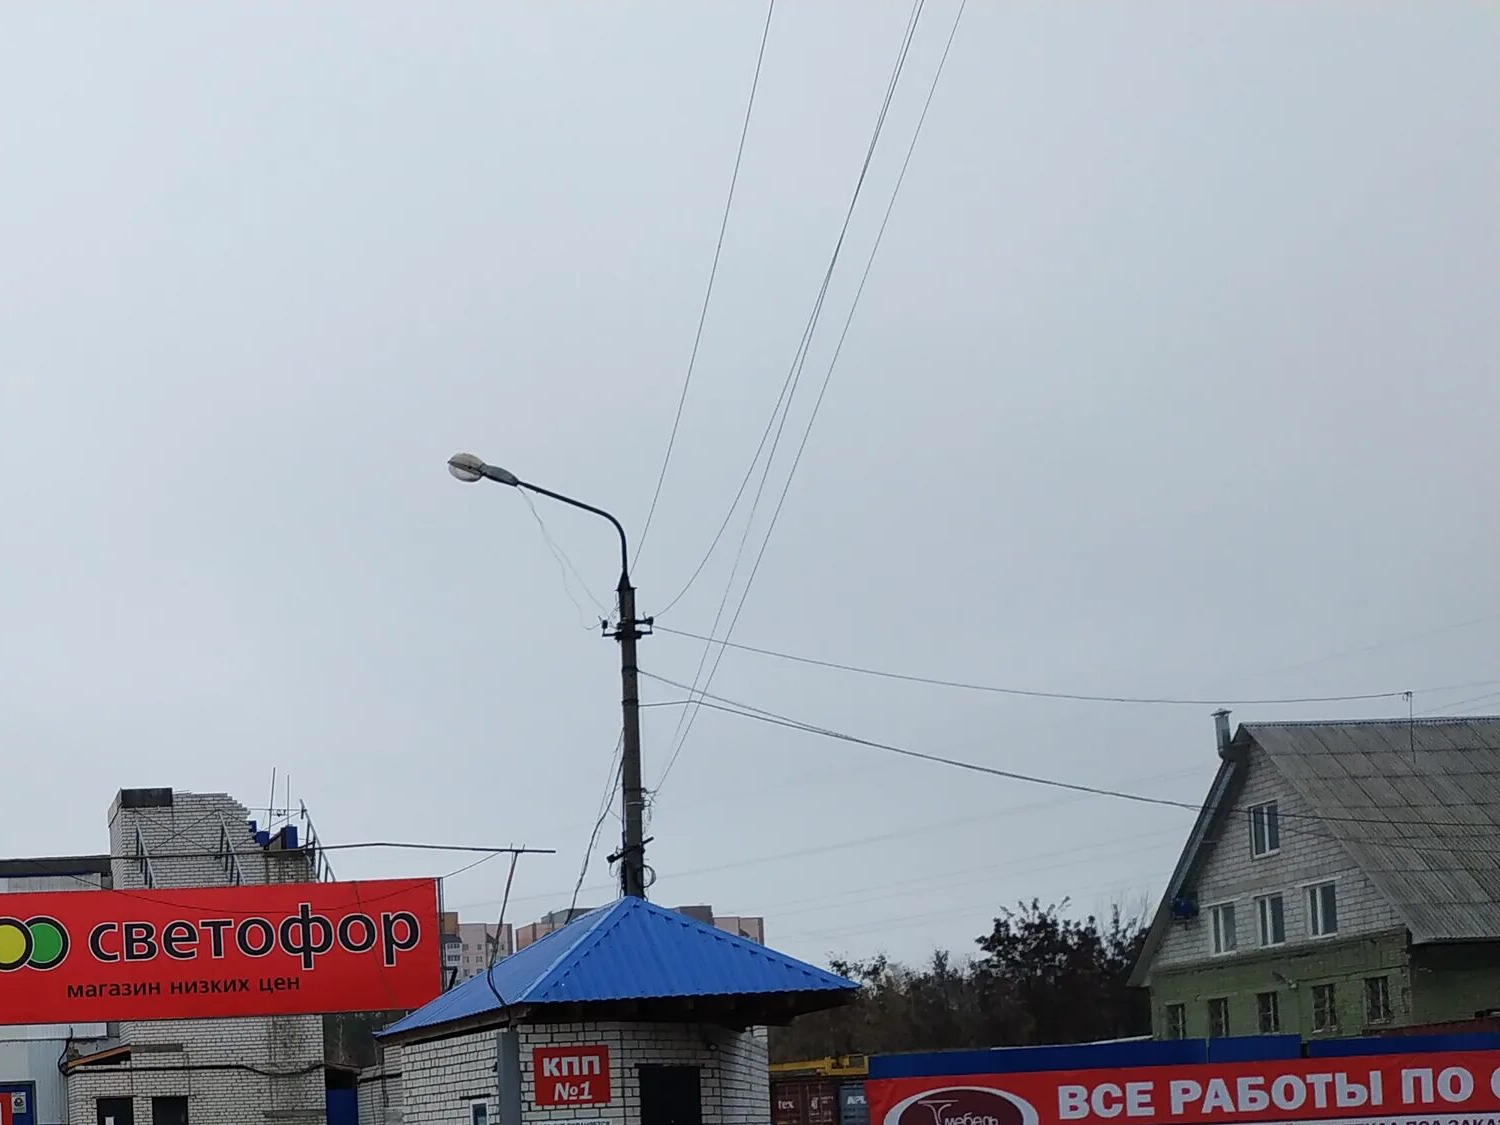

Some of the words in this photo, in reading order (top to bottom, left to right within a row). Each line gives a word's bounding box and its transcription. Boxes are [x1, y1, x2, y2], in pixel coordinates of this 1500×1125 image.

[88, 903, 421, 971] светофор
[67, 981, 161, 999] магазин
[170, 979, 250, 995] низких
[258, 976, 301, 994] цен
[542, 1055, 601, 1077] КПП
[554, 1081, 593, 1101] №1
[1057, 1081, 1156, 1120] ВСЕ
[1169, 1070, 1383, 1115] РАБОТЫ
[1401, 1066, 1474, 1104] ПО
